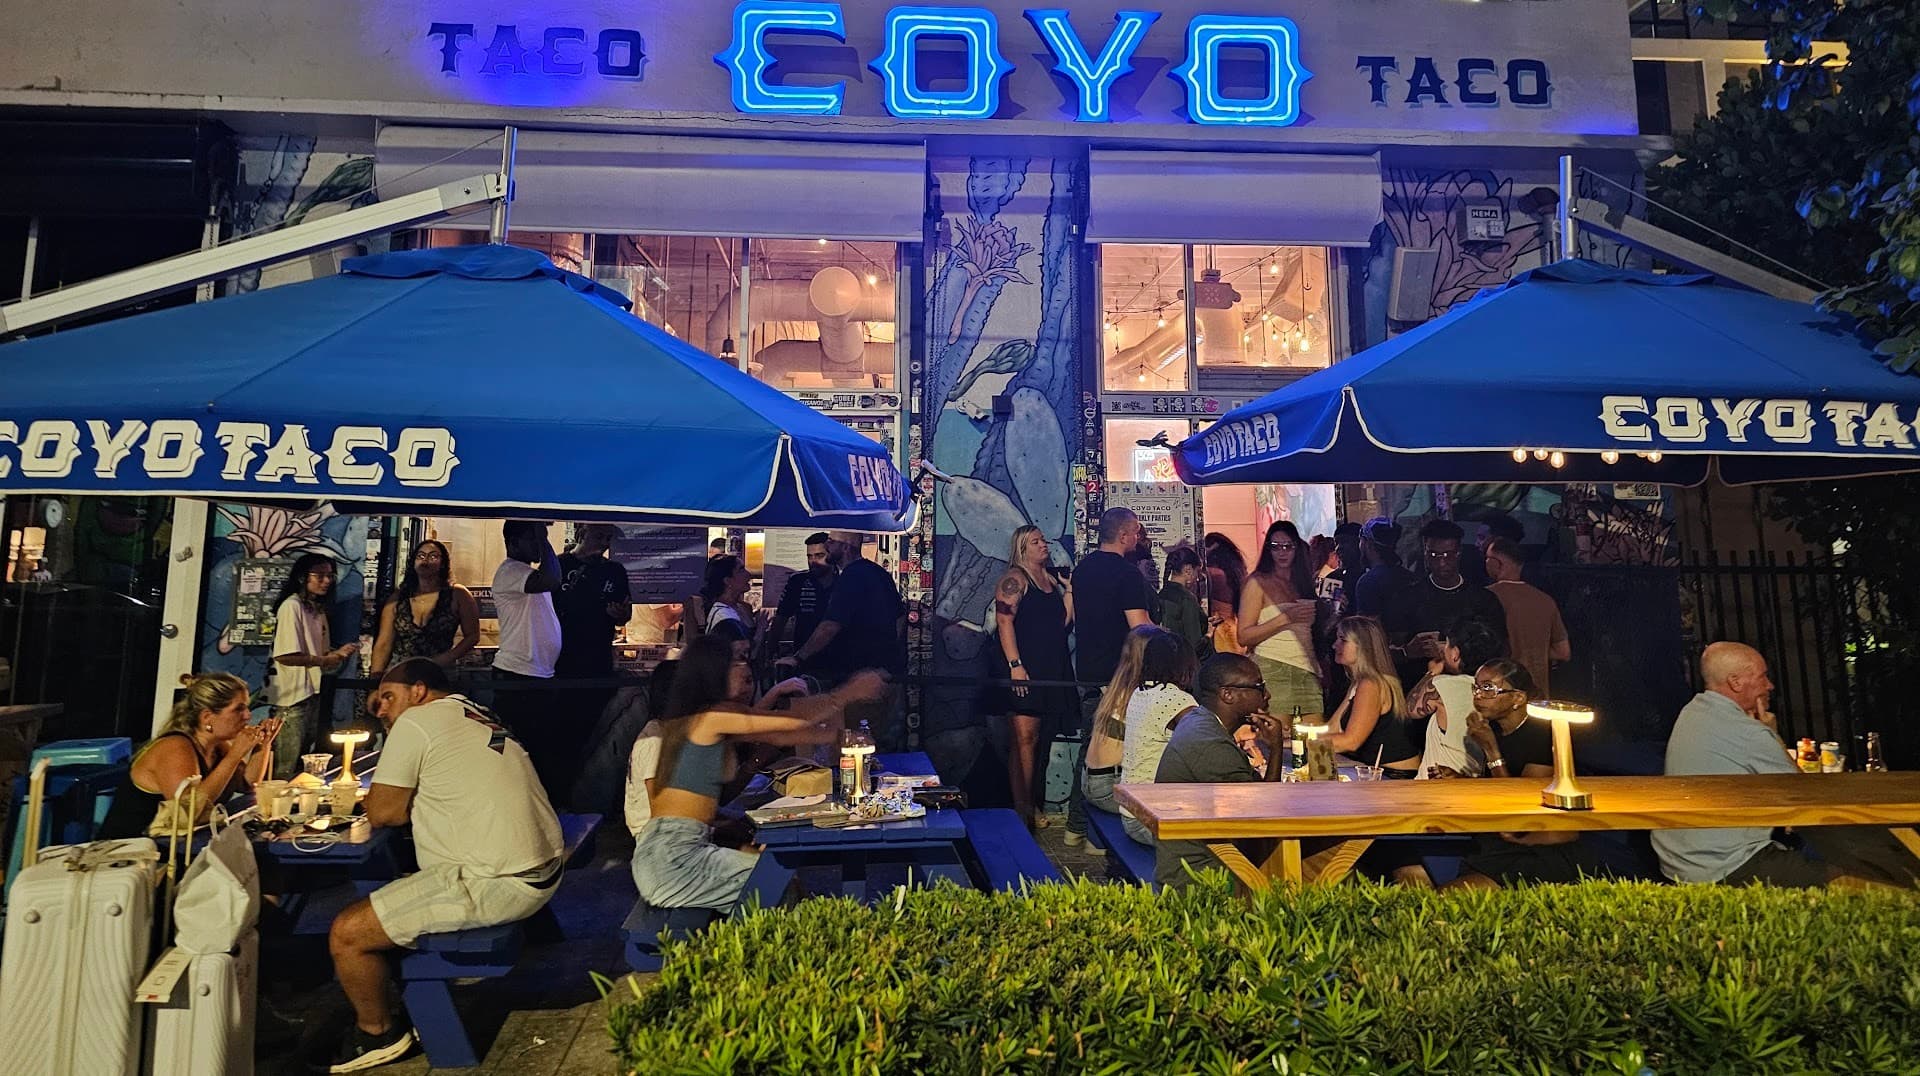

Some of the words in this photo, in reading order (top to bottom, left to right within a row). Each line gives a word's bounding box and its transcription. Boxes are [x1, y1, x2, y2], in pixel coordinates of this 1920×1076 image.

[427, 22, 649, 81] TACO
[713, 0, 1314, 125] COYO
[1355, 55, 1555, 109] TACO
[1203, 424, 1237, 468] COYO
[1230, 412, 1280, 457] TACO
[1598, 395, 1817, 444] COYO
[1822, 400, 1920, 450] TA
[215, 421, 461, 488] TACO
[847, 453, 893, 502] COYO
